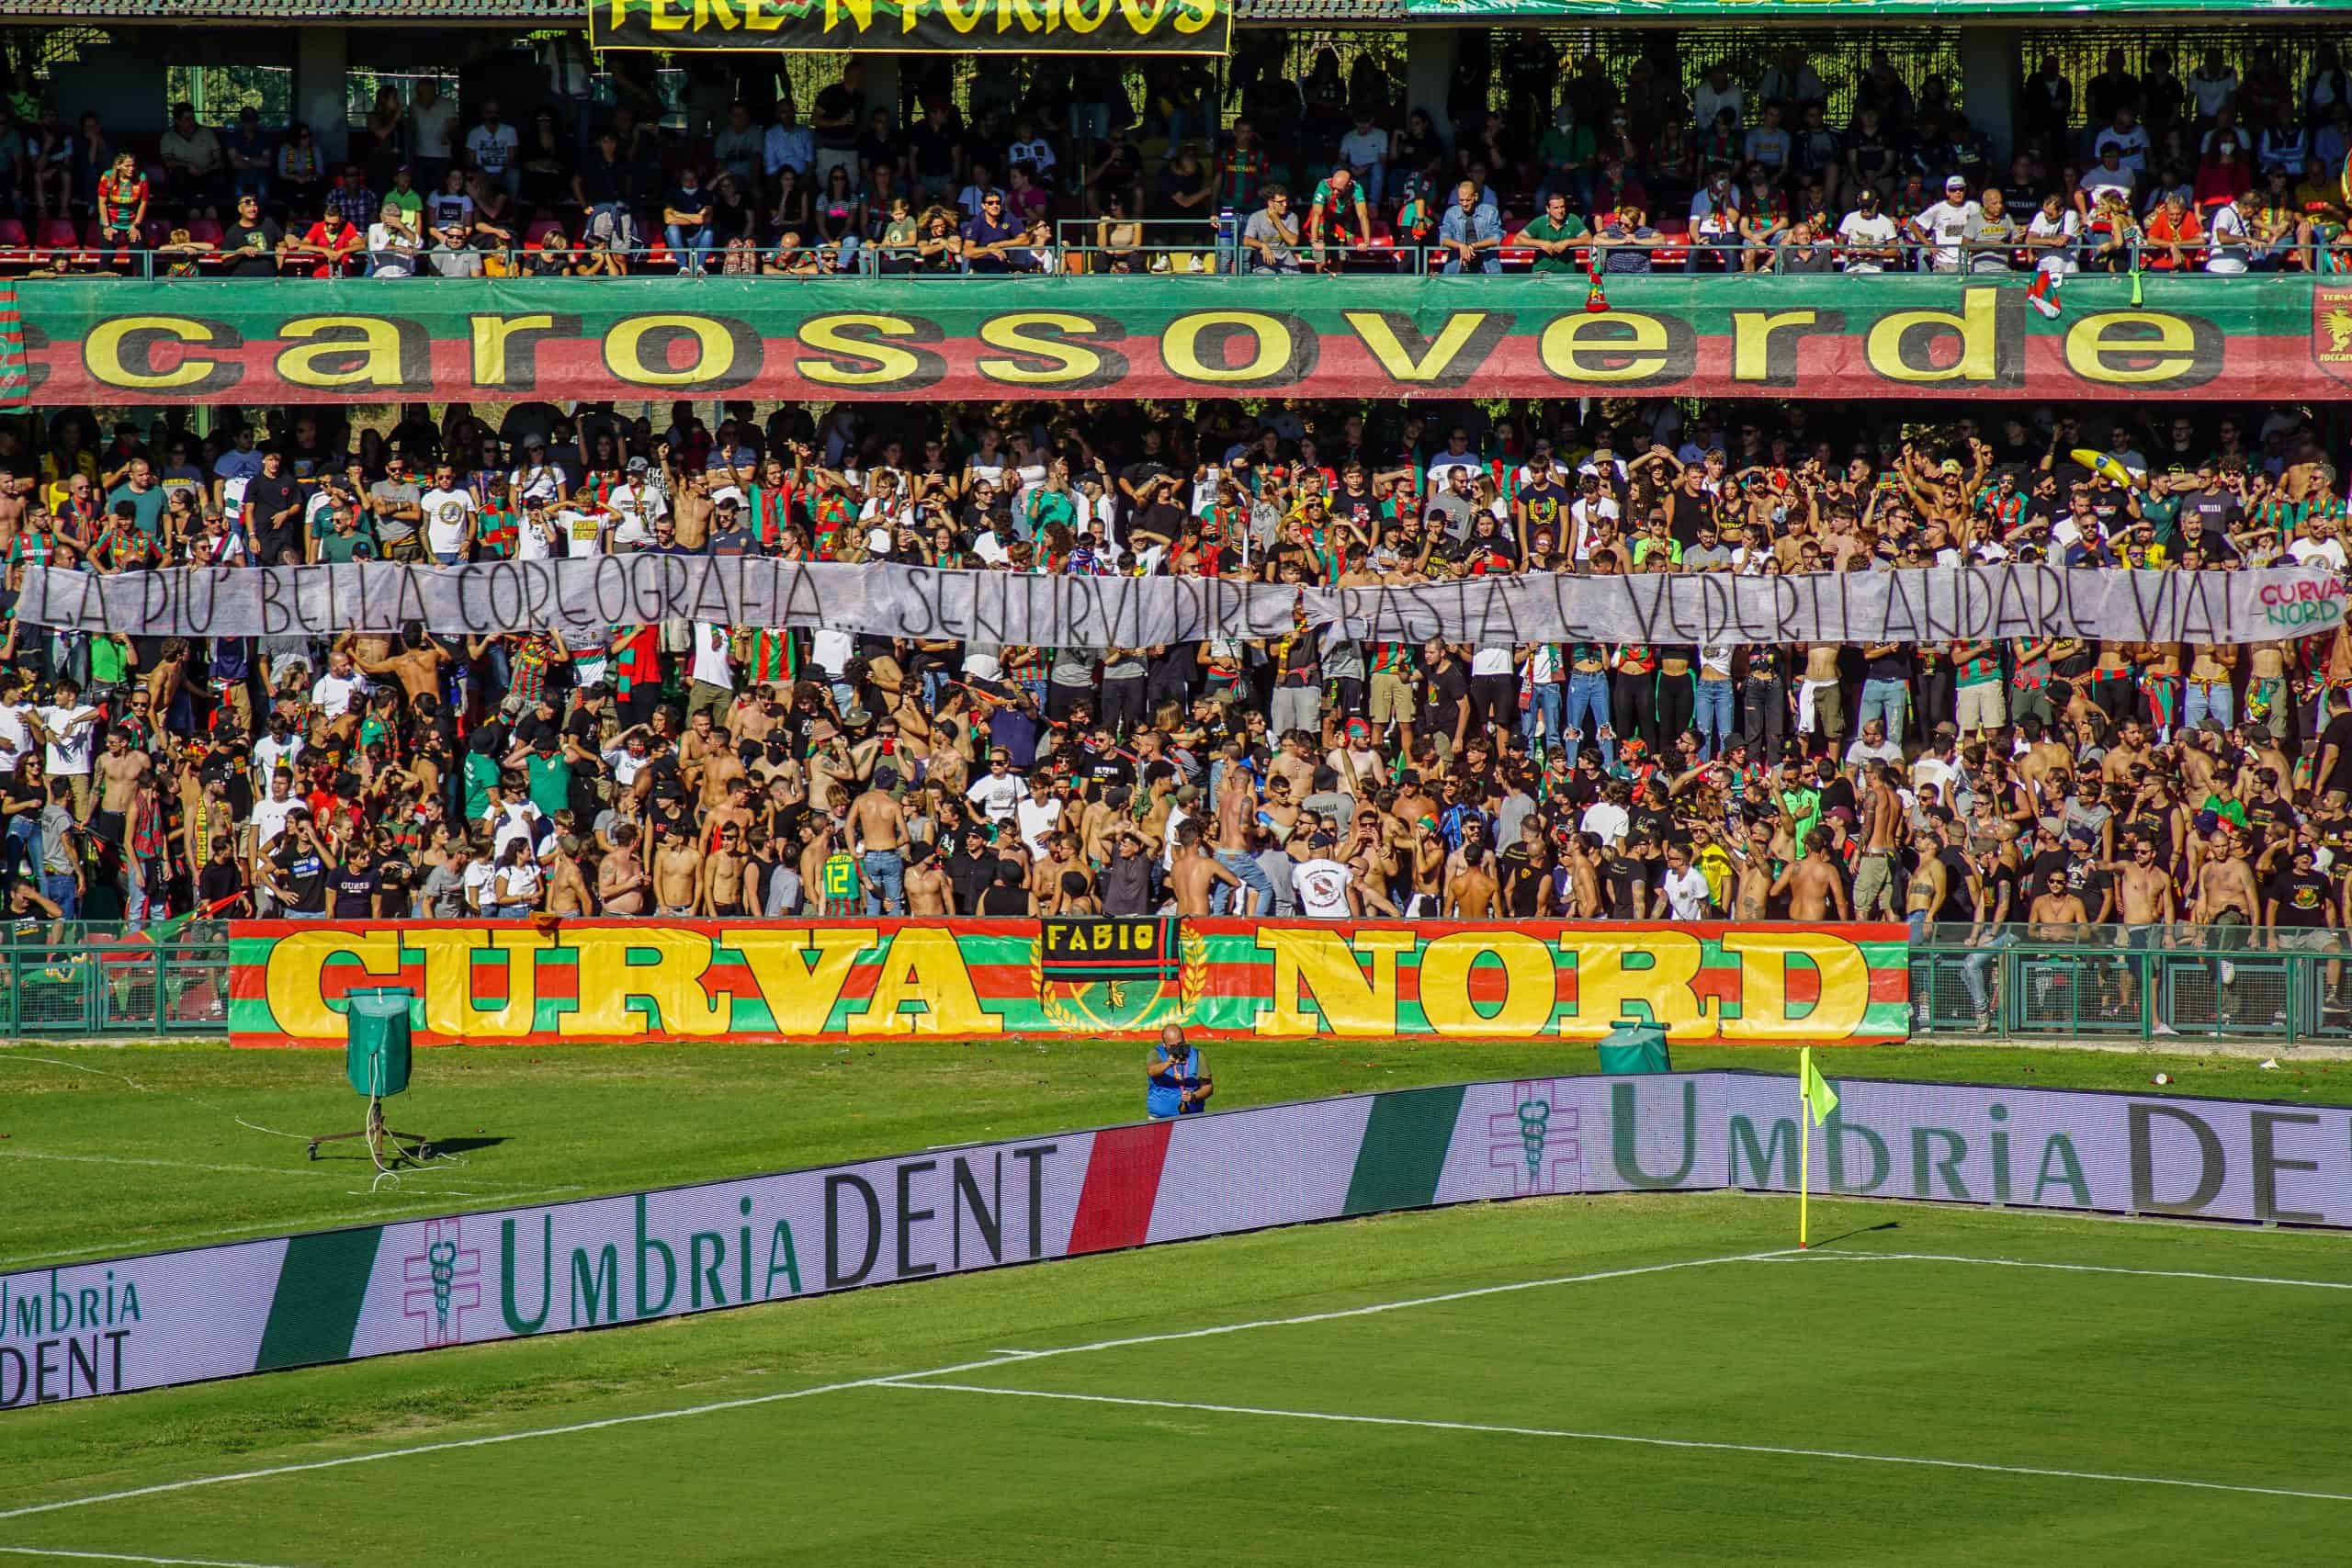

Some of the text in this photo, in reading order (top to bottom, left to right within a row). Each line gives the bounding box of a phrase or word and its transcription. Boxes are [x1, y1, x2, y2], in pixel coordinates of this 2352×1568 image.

[41, 565, 110, 632] LA
[263, 563, 429, 634] BELLA
[899, 570, 1142, 645] SENTIRVI
[1173, 576, 1272, 642] DIRE
[1555, 574, 1588, 641] E
[1625, 571, 1849, 642] VEDERTI
[1883, 564, 2099, 640] ANDARE
[2131, 569, 2233, 642] VIA!
[2259, 577, 2346, 605] CURVA
[2266, 600, 2340, 626] NORD
[827, 864, 849, 893] 12
[1046, 924, 1155, 951] FABIO
[265, 925, 1870, 1040] CURVA NORD
[827, 1143, 1058, 1288] DENT
